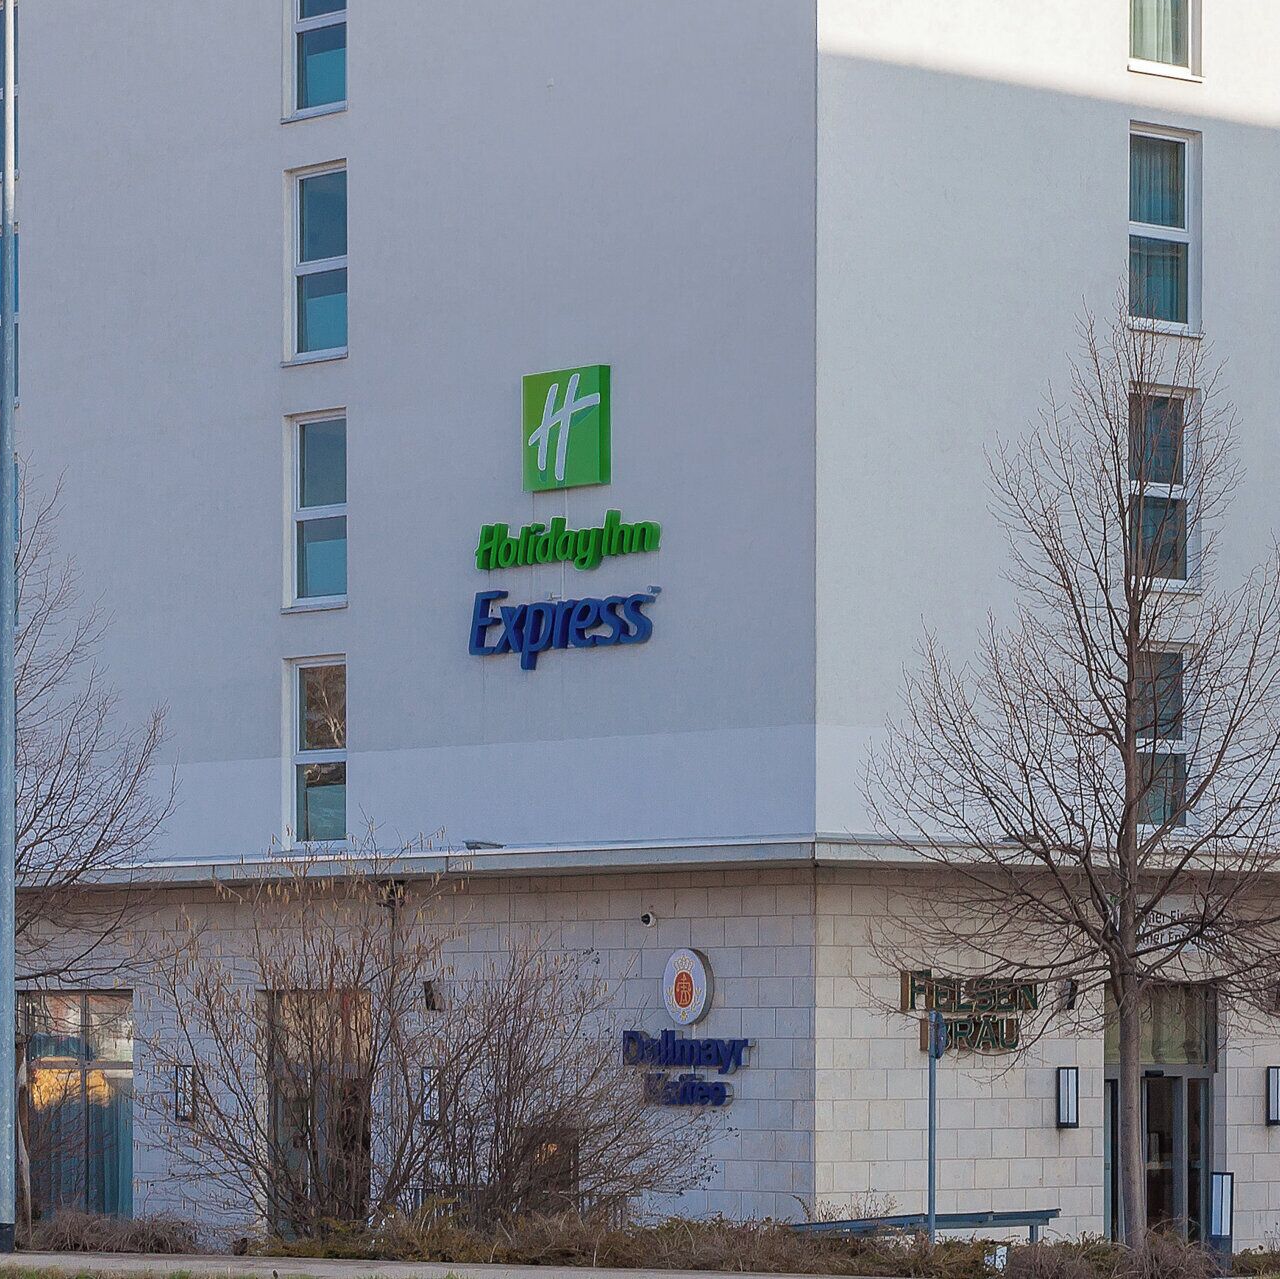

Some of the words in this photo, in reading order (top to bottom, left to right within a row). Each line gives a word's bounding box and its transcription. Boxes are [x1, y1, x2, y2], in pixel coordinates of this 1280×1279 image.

[474, 515, 605, 571] Holiday
[601, 508, 662, 556] Inn
[468, 588, 657, 671] Express
[902, 968, 1039, 1012] FELSEN
